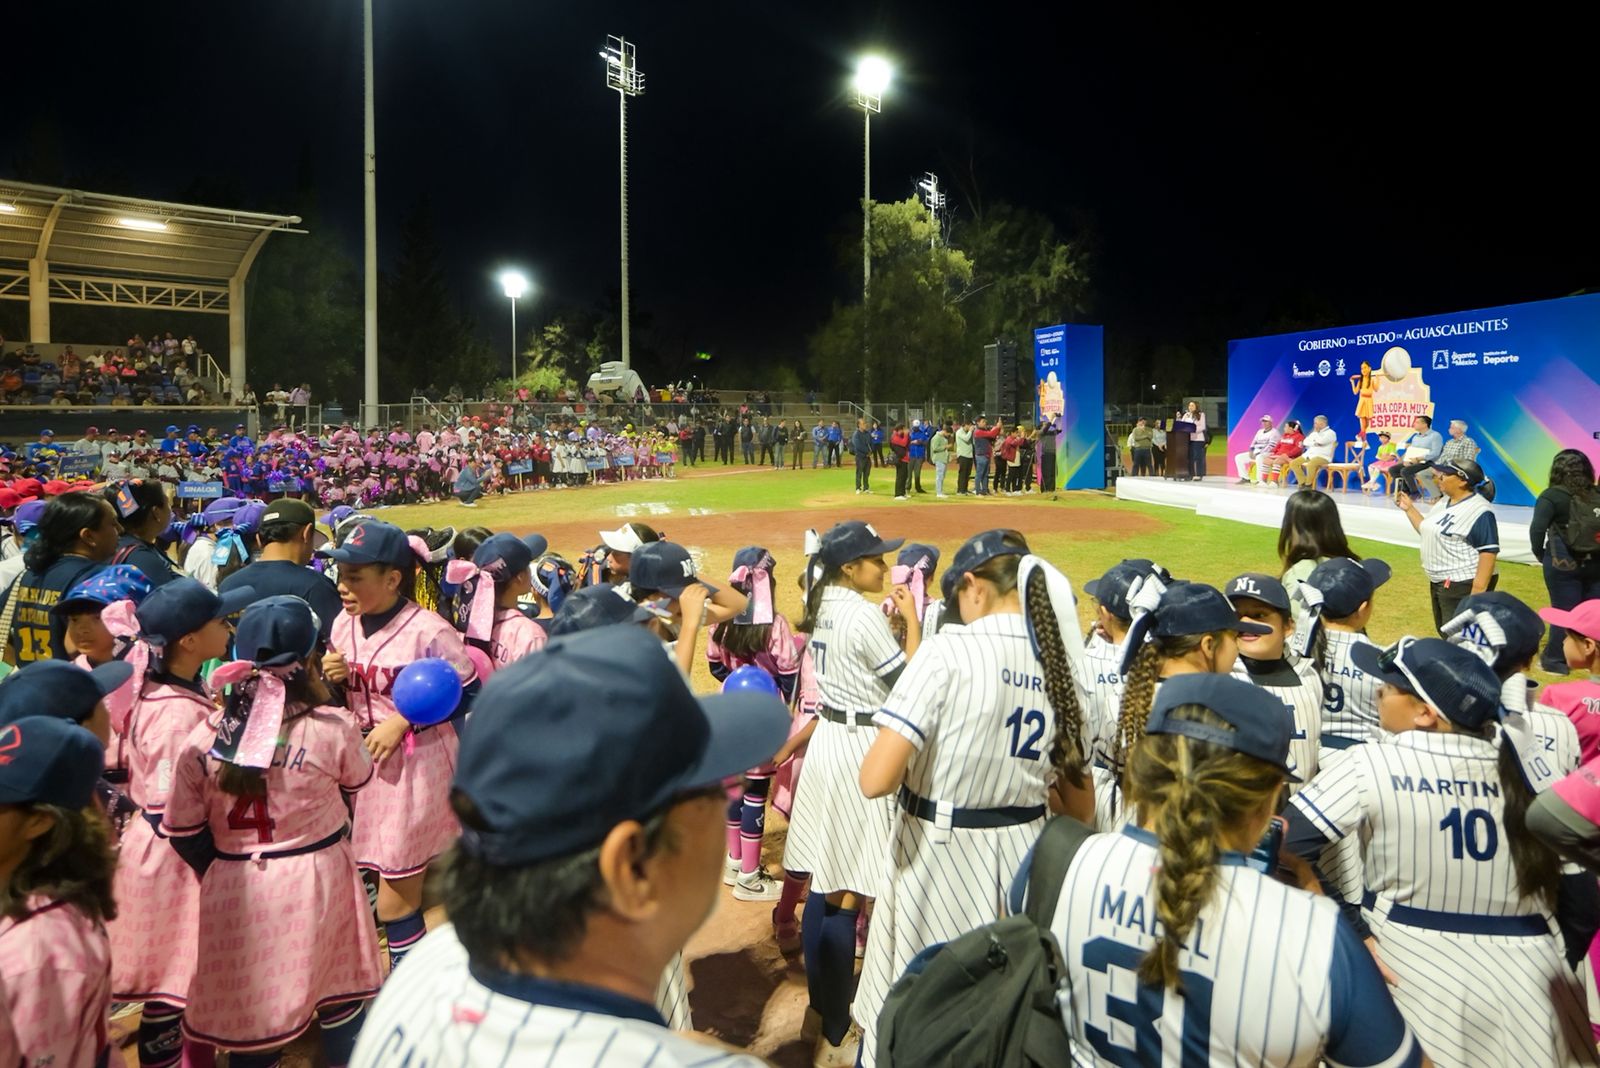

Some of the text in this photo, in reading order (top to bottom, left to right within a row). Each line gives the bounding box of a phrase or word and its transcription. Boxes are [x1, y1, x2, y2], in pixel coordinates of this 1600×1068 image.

[1298, 337, 1347, 352] GOBIERNO
[1356, 331, 1396, 346] ESTADO
[1403, 318, 1509, 340] AGUASCALIENTES
[1483, 355, 1519, 366] Deporte
[1370, 414, 1418, 428] ESPECI
[1373, 402, 1429, 415] UNA COPA MUY
[1234, 576, 1261, 595] NL
[18, 626, 53, 661] 13
[1324, 683, 1345, 713] 9
[1005, 706, 1046, 761] 12
[1391, 775, 1499, 798] MARTIN
[227, 785, 277, 844] 4
[1439, 807, 1498, 861] 10
